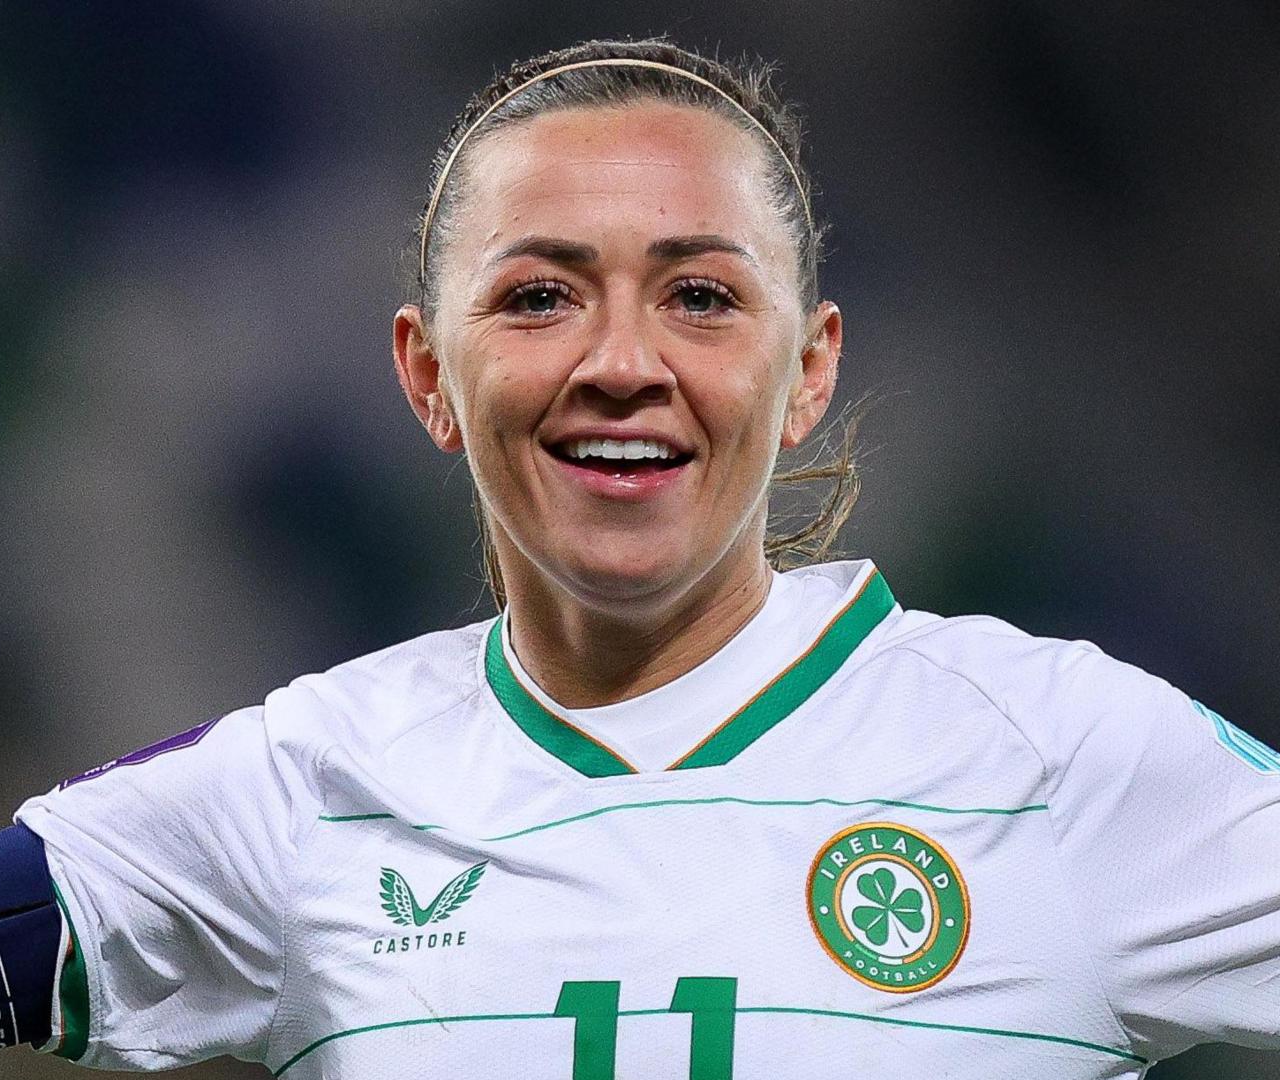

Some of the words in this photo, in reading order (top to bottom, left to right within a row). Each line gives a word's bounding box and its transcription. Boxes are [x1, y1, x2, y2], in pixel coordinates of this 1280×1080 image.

[821, 834, 949, 888] IRELAND
[373, 931, 466, 954] CASTORE
[843, 951, 937, 982] FOOTBALL
